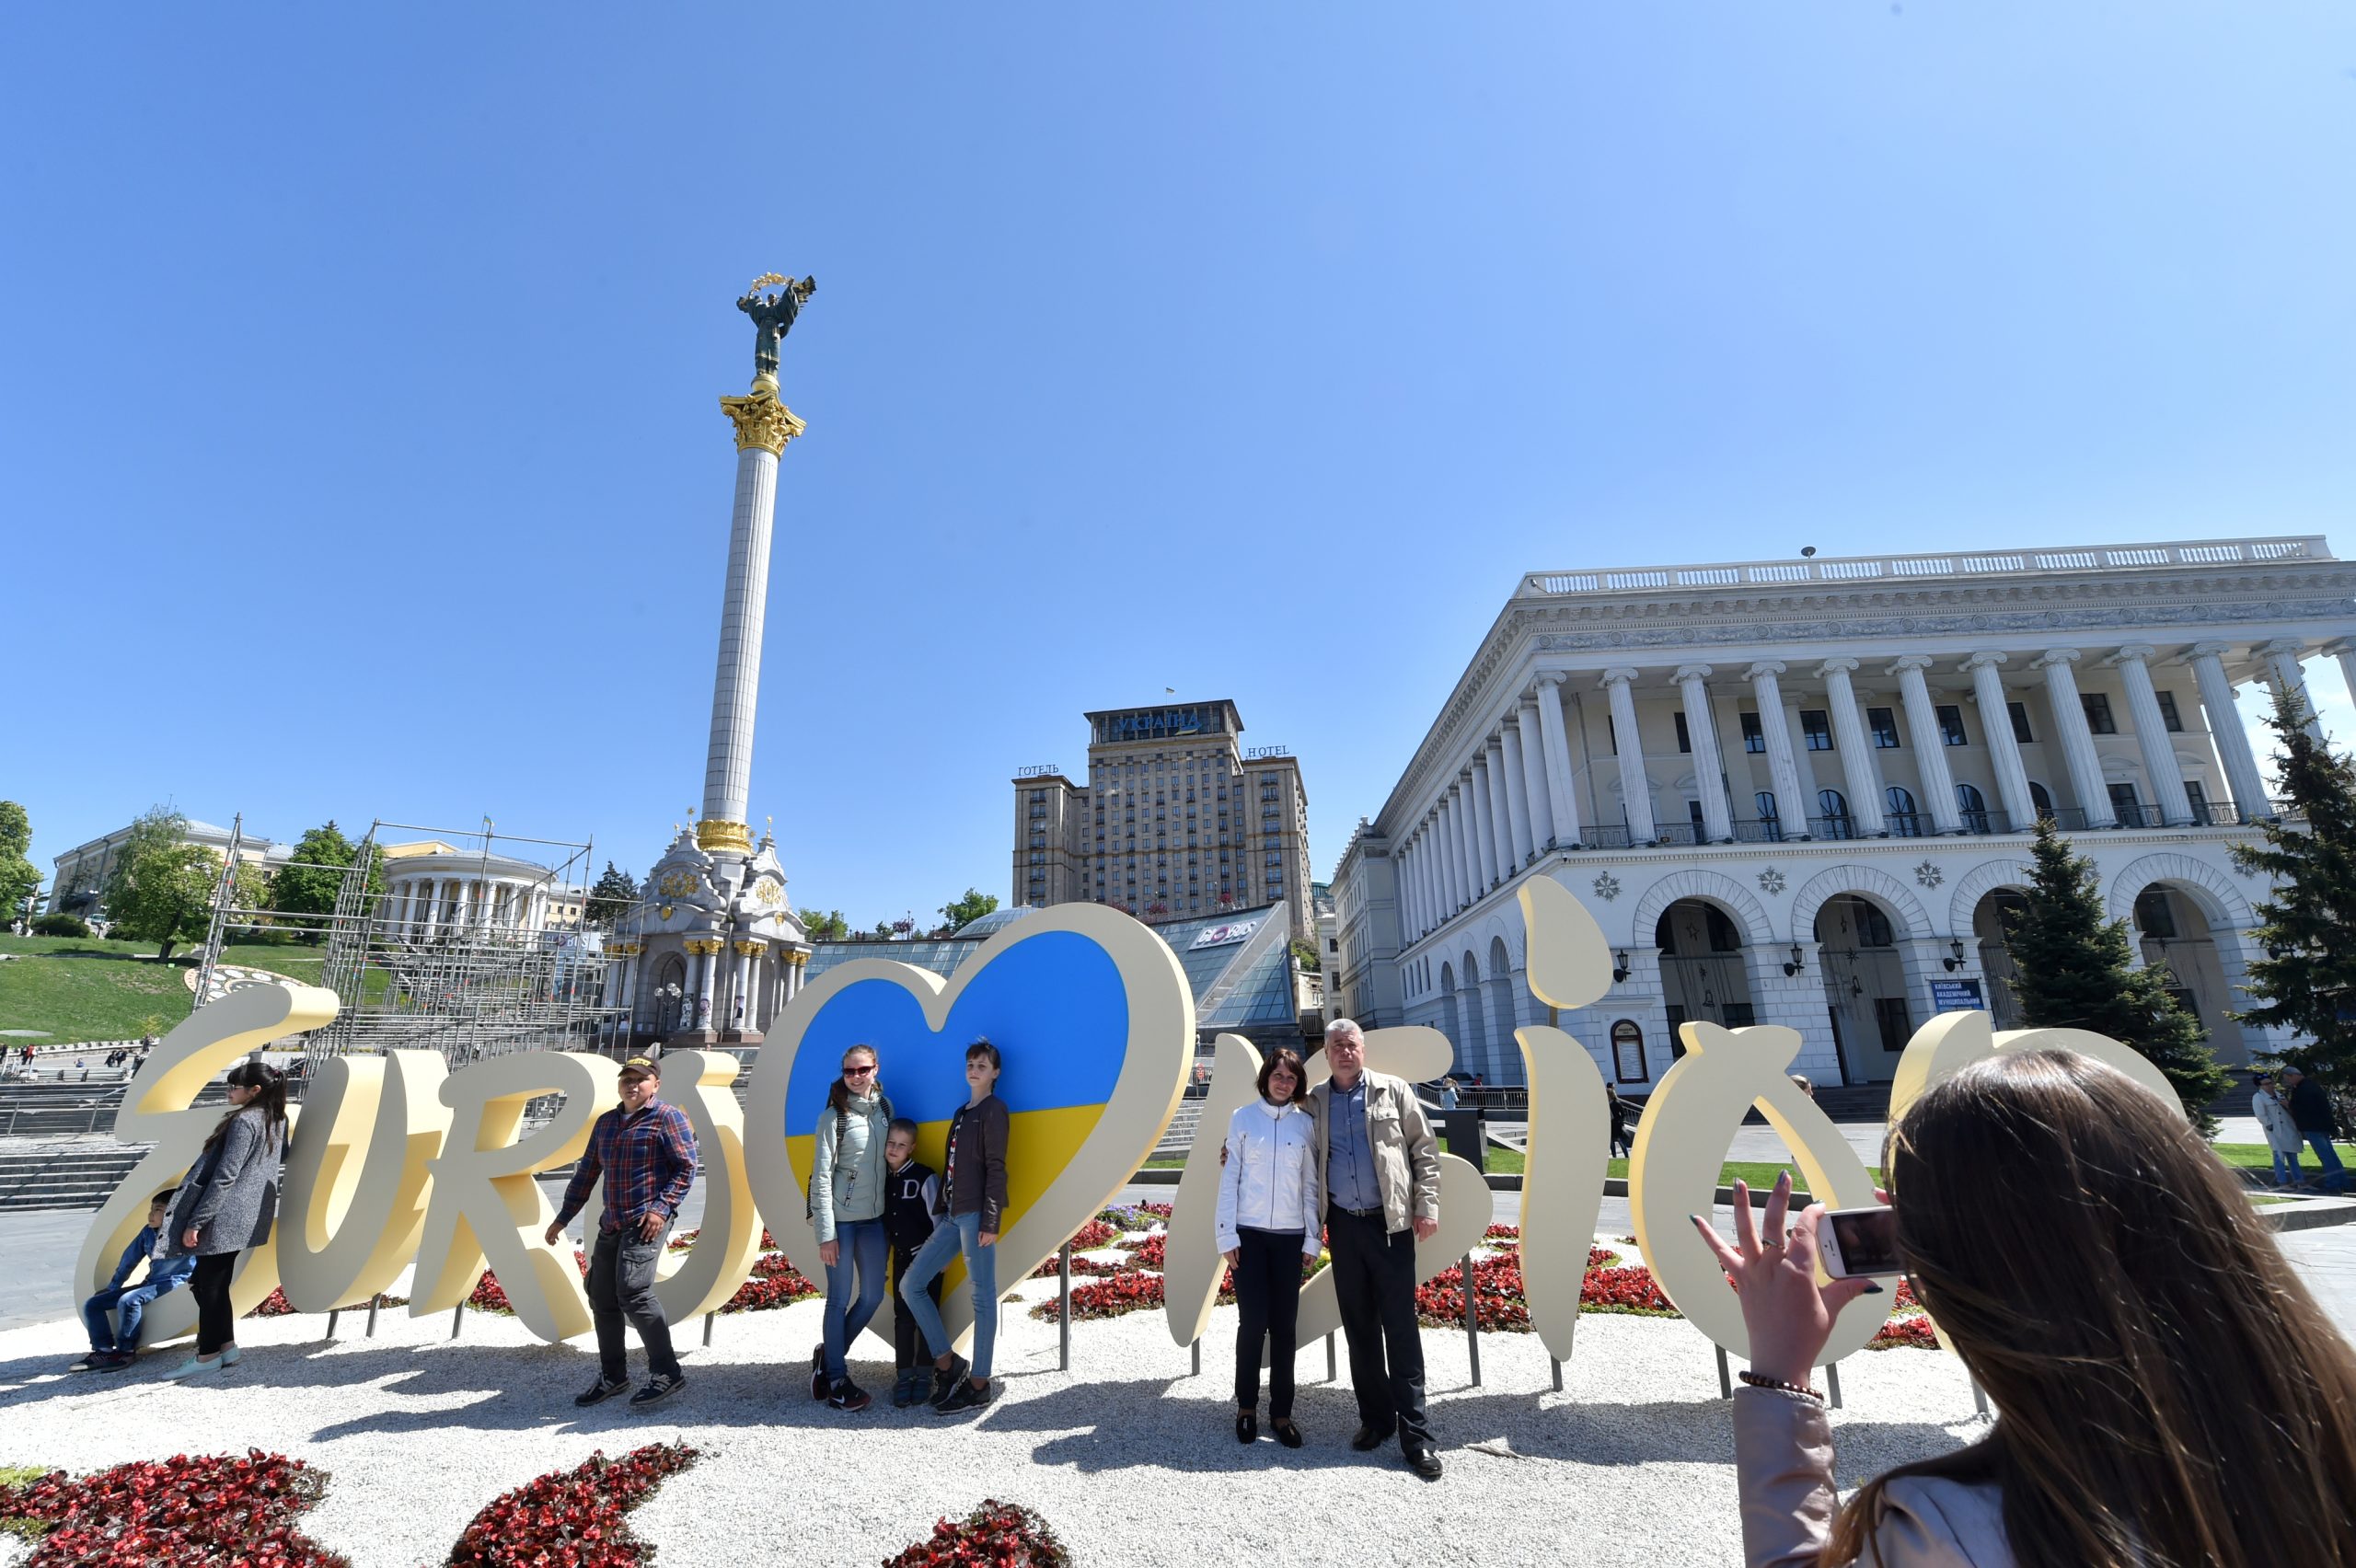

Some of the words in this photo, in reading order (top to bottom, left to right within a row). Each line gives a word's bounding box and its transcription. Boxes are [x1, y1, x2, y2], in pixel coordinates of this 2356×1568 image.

[1248, 745, 1289, 756] HOTEL
[1018, 764, 1058, 776] ГОТЕЛЬ
[1197, 921, 1256, 943] GLOBUS
[901, 1179, 919, 1199] D
